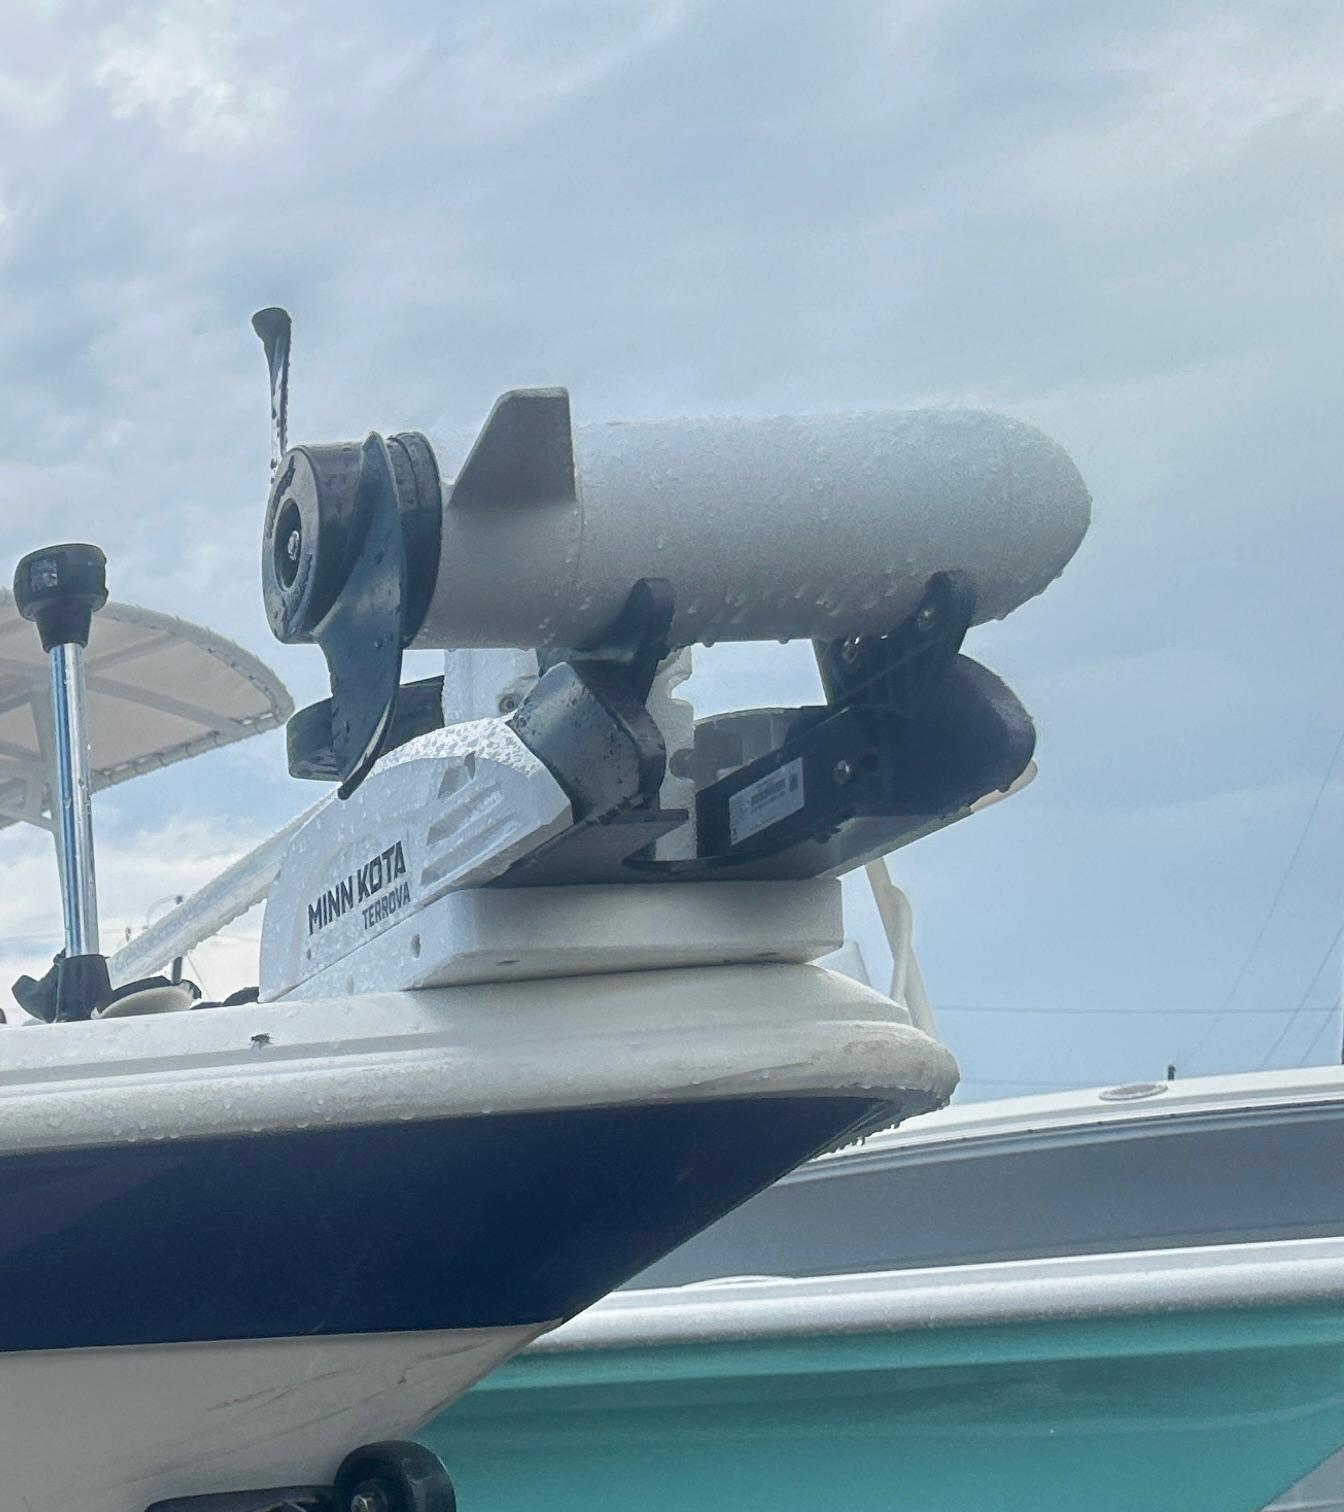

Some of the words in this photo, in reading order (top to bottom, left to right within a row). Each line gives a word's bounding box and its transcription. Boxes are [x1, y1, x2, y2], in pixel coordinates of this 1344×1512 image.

[308, 875, 353, 935] MINN
[357, 840, 406, 903] KOTA
[362, 882, 411, 930] TERROVA
